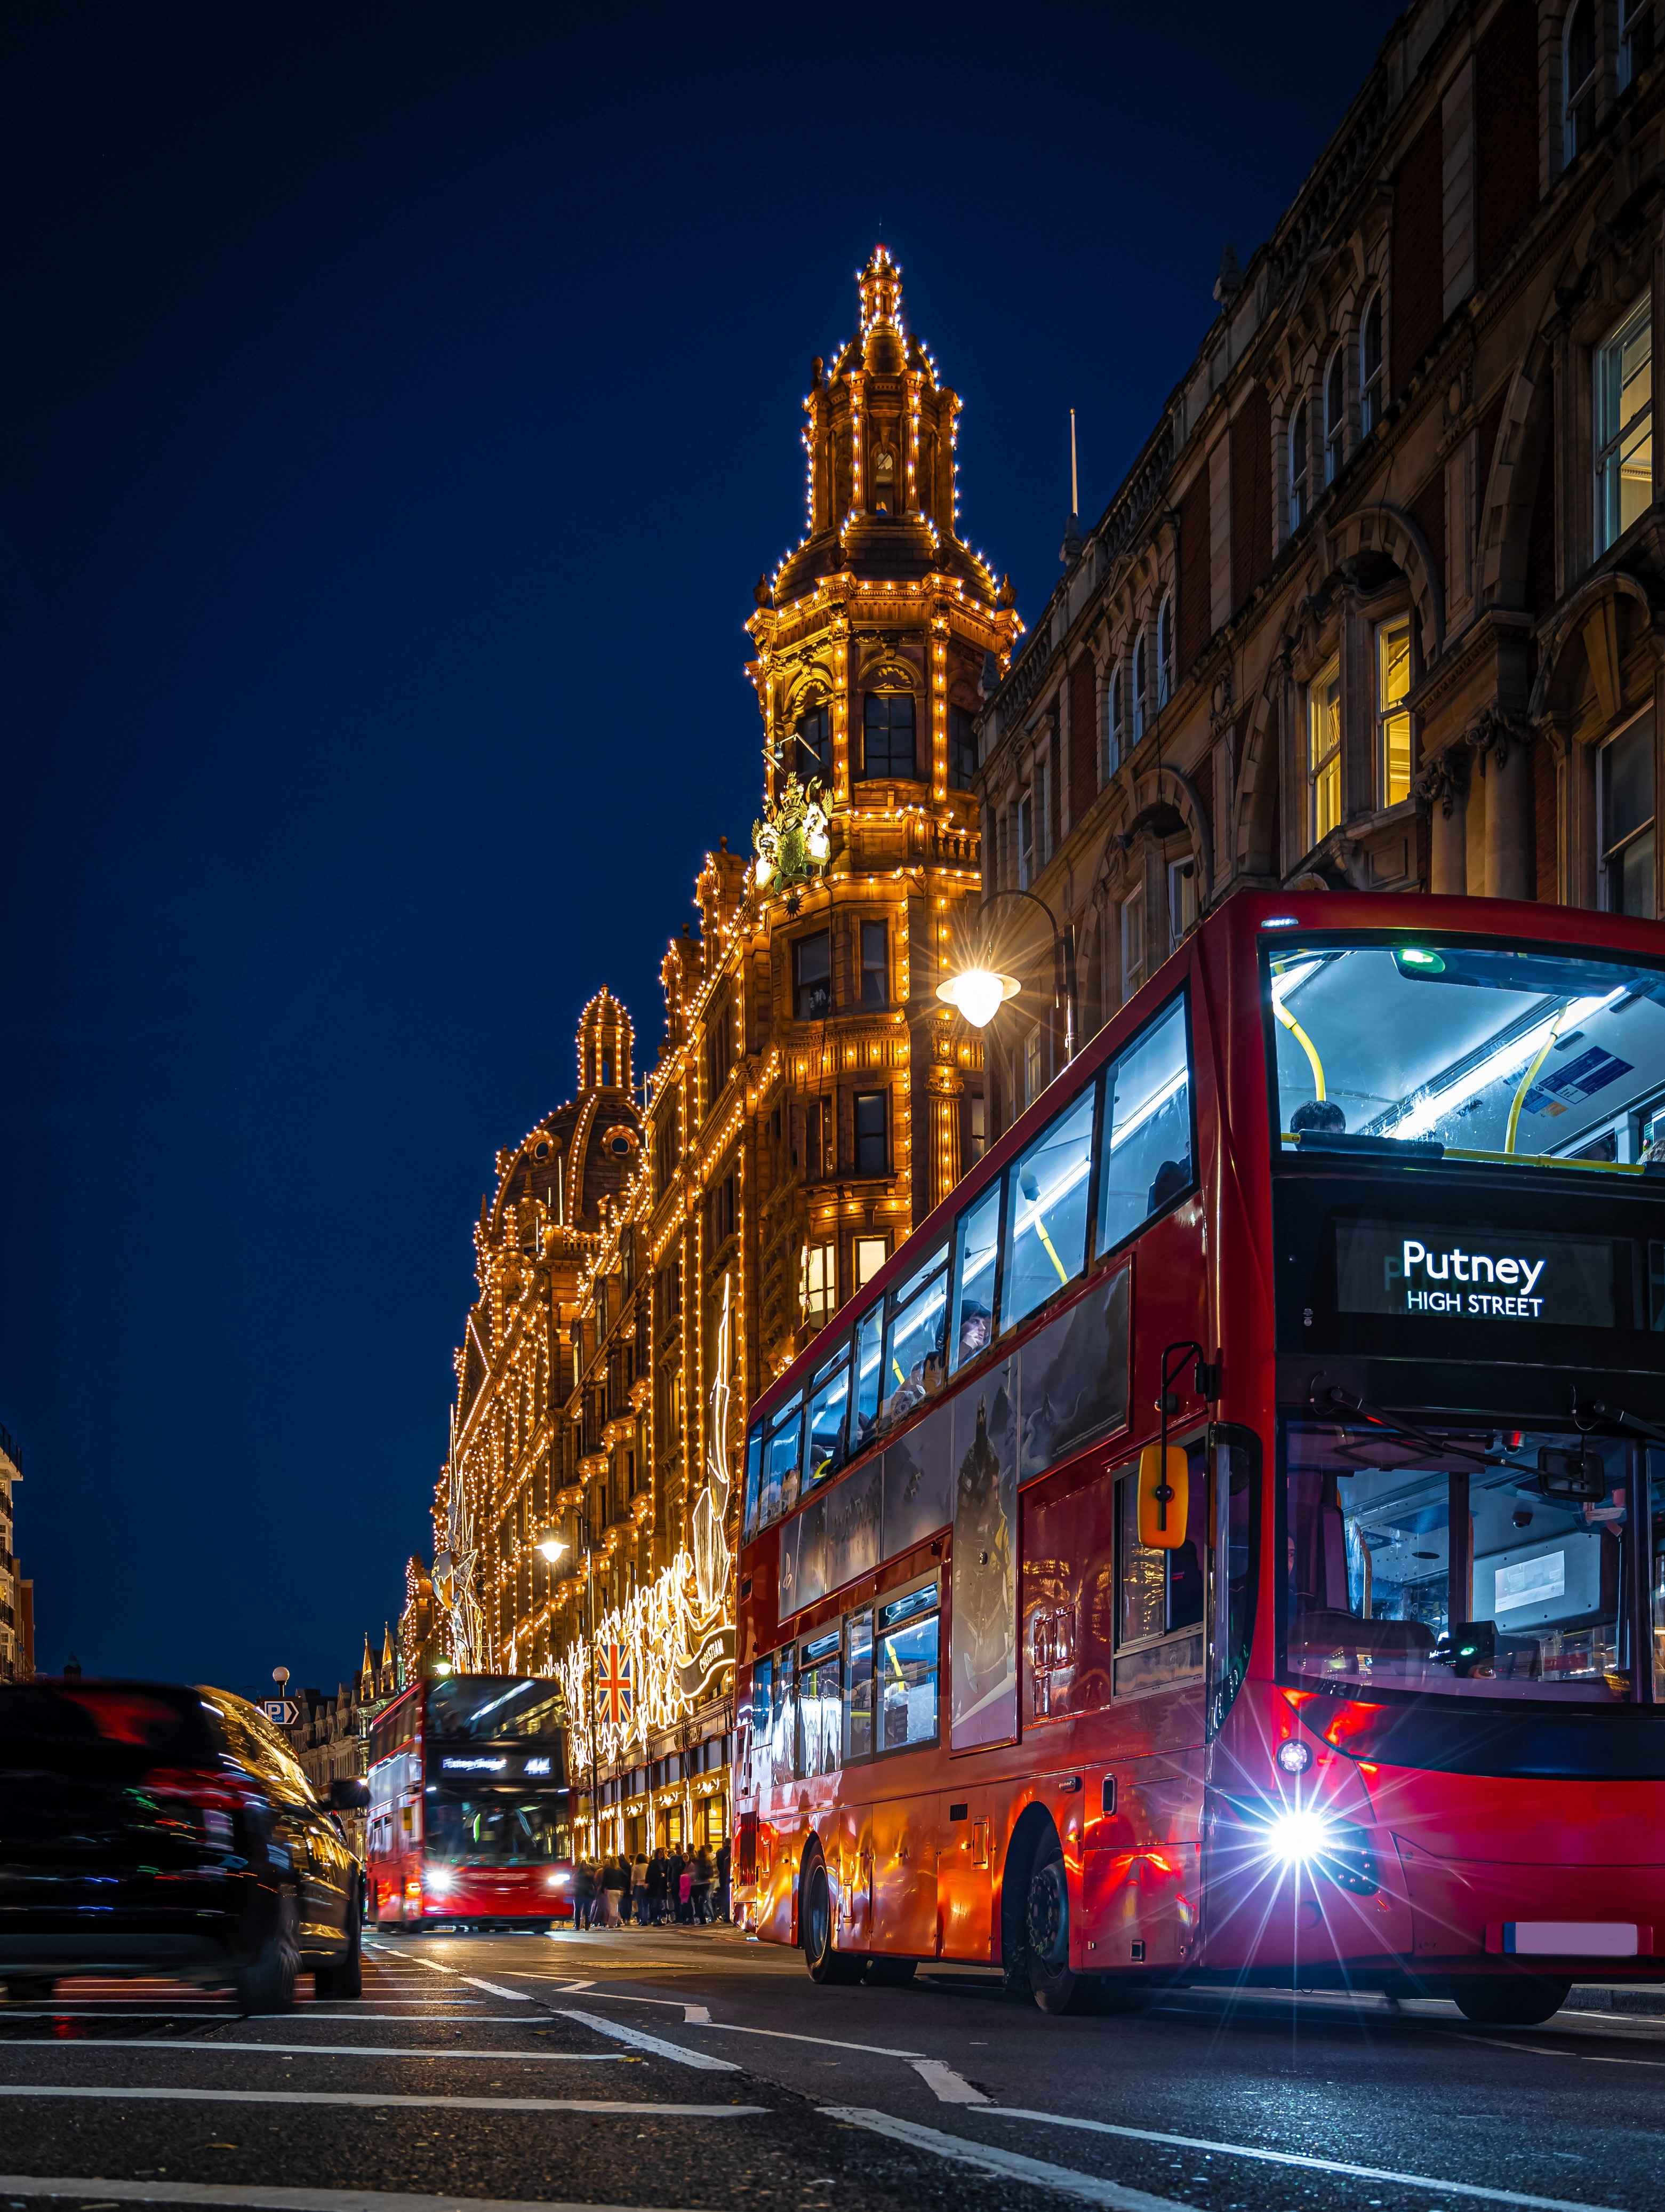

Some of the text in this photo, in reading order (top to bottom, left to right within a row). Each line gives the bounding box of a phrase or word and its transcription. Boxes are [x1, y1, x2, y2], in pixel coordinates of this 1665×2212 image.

[1403, 1241, 1545, 1295] Putney
[1407, 1290, 1543, 1317] HIGH STREET
[268, 1704, 281, 1720] P
